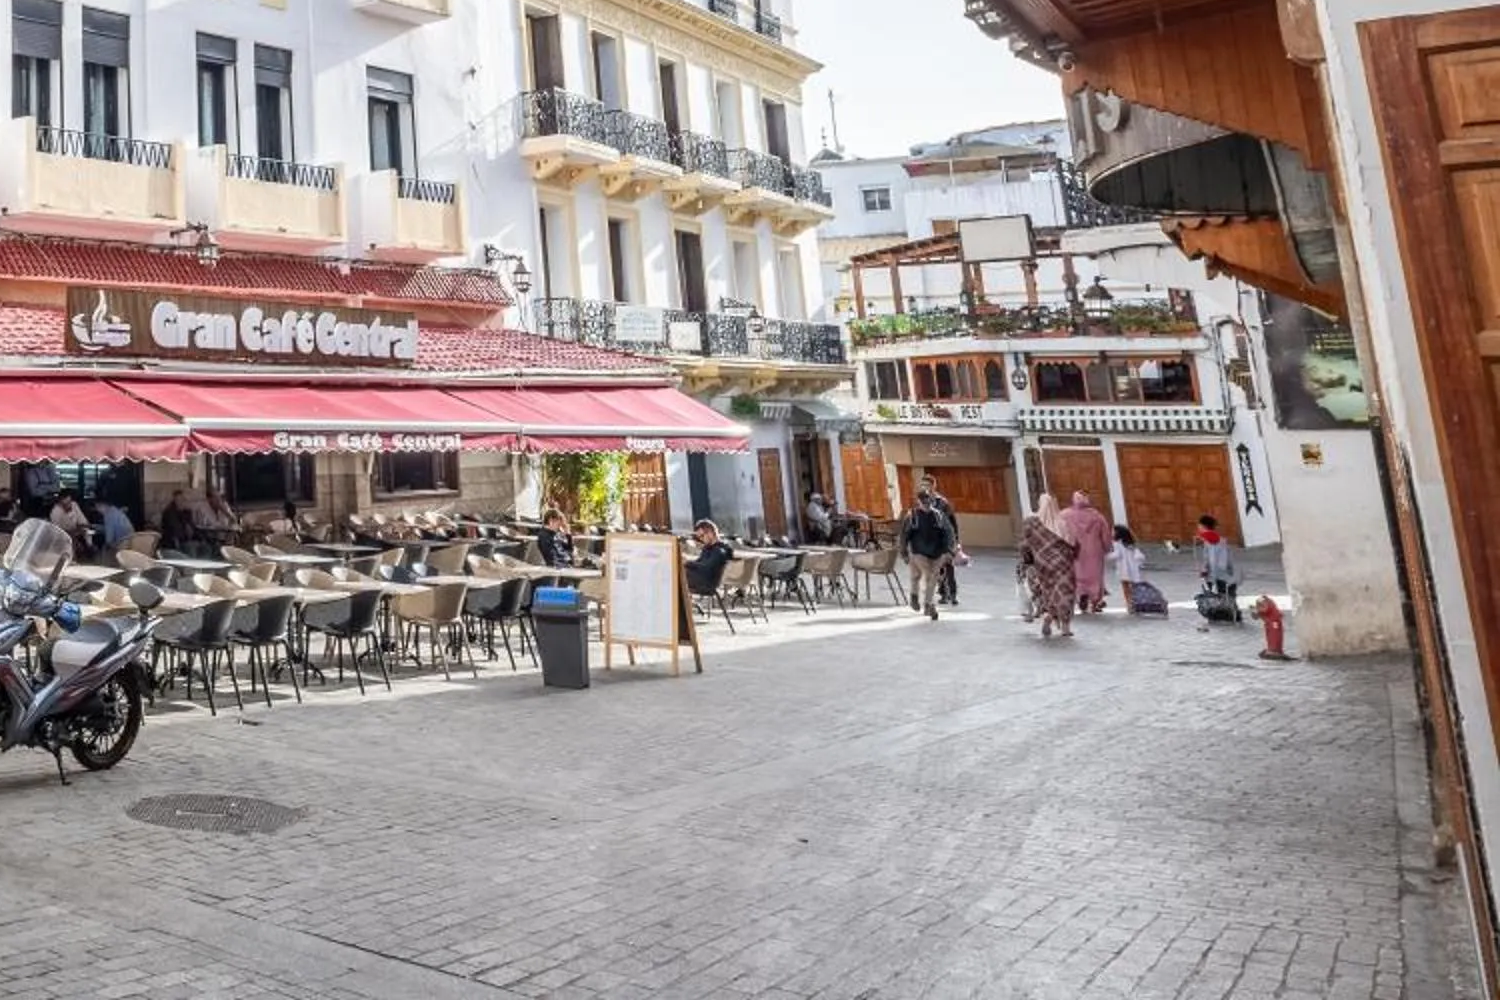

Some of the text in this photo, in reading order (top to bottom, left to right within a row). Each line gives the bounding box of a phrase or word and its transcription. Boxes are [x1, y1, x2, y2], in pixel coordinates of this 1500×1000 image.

[151, 301, 419, 359] Gran Café Central
[273, 431, 462, 449] Gran Café Central
